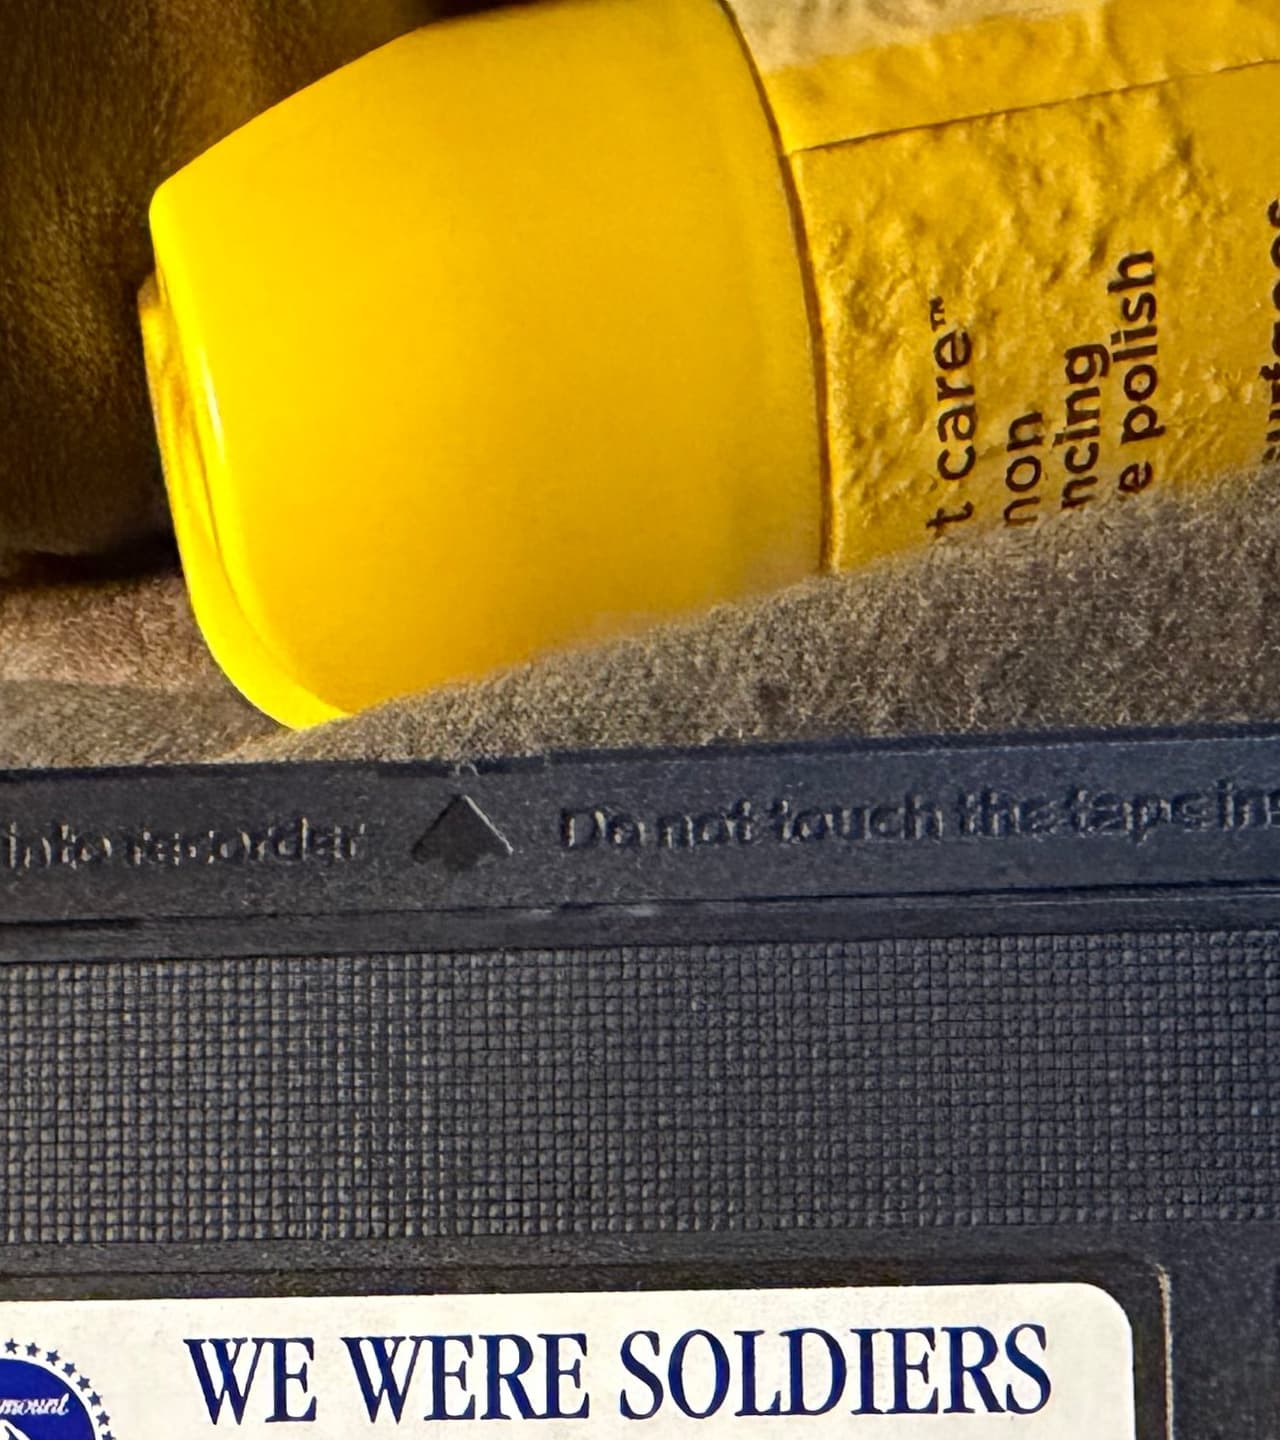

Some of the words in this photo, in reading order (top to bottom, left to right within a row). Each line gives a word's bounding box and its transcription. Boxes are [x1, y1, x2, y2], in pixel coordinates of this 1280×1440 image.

[1108, 251, 1165, 442] polish
[6, 819, 114, 871] into
[560, 806, 647, 849] Do
[656, 798, 756, 850] not
[772, 792, 945, 846] touch
[957, 789, 1058, 842] the
[182, 1335, 318, 1426] WE
[340, 1332, 591, 1425] WERE
[618, 1322, 1053, 1420] SOLDIERS
